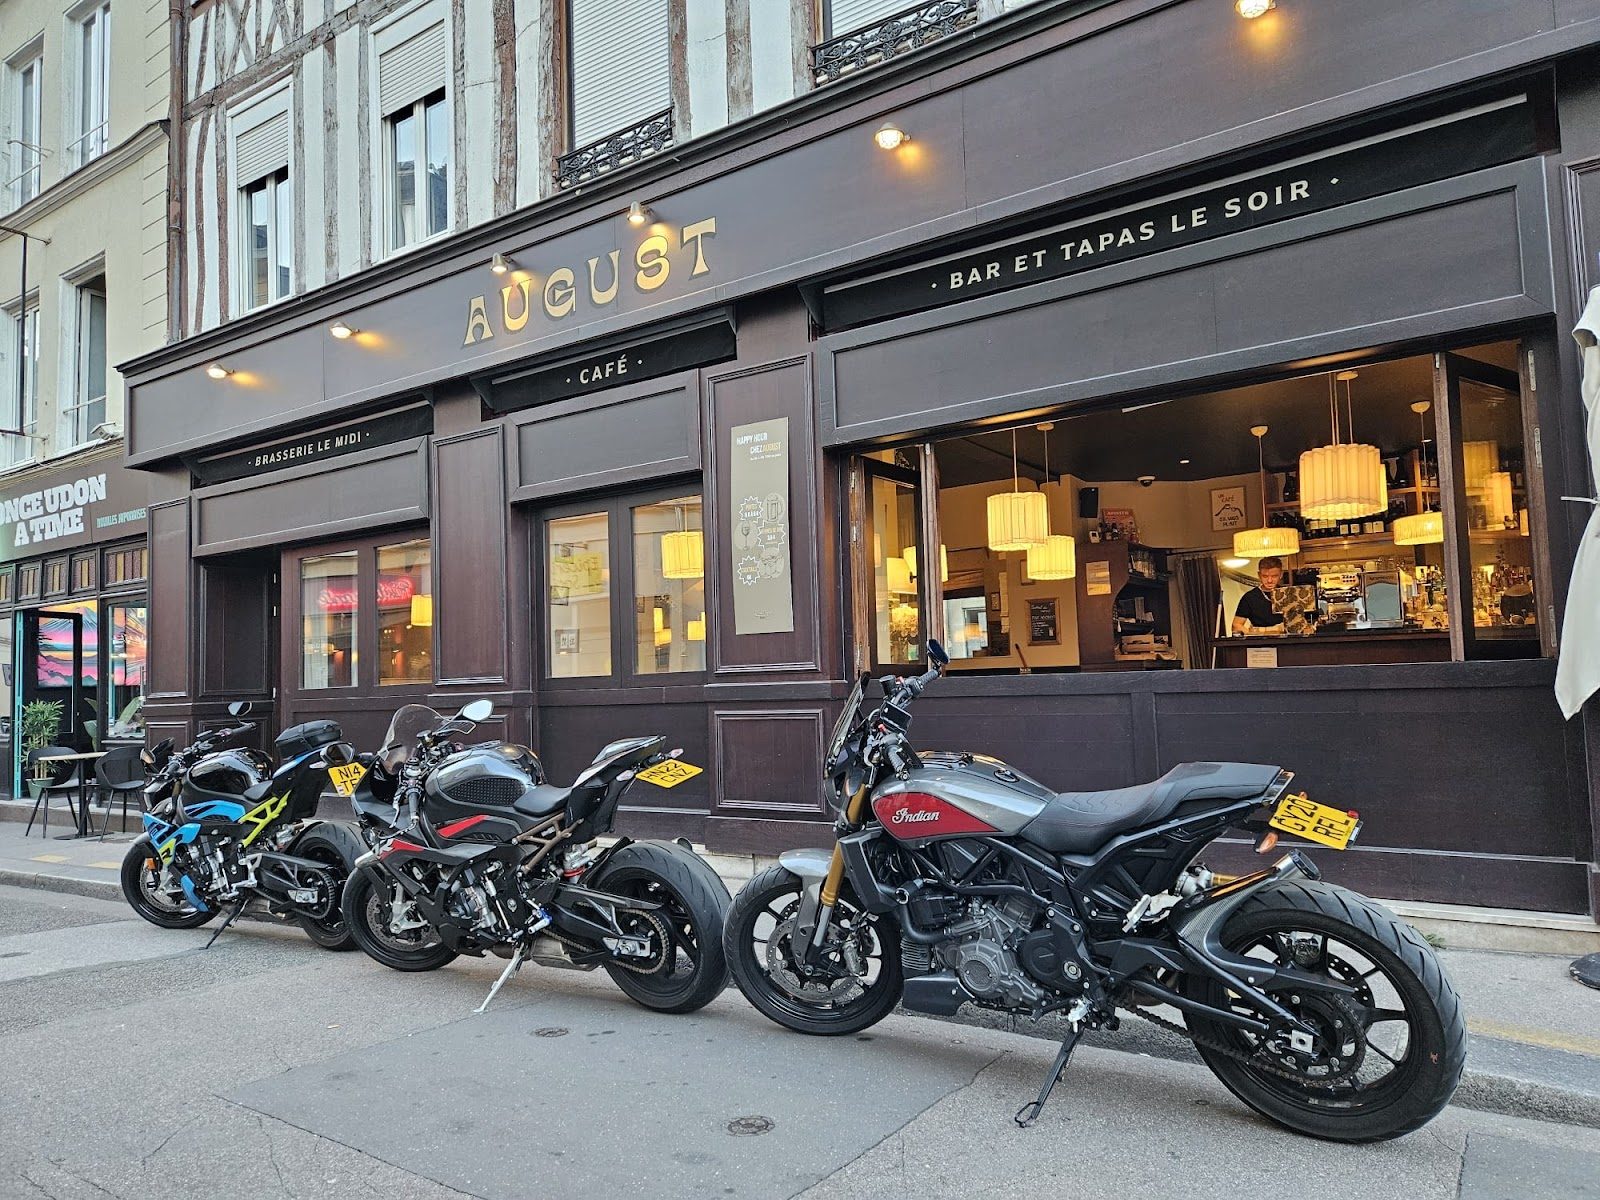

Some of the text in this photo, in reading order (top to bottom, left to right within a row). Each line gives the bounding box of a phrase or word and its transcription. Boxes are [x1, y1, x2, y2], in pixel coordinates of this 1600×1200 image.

[949, 179, 1311, 290] BAR ET TAPAS LE SOIR
[461, 216, 717, 348] AUGUST
[579, 353, 628, 384] CAFÉ
[254, 431, 361, 467] BRASSERIE LE MIDI
[44, 473, 107, 514] UDON
[14, 507, 84, 547] A TIME
[891, 807, 940, 824] Indian
[1276, 798, 1319, 832] GY20
[1312, 815, 1351, 841] RFL
